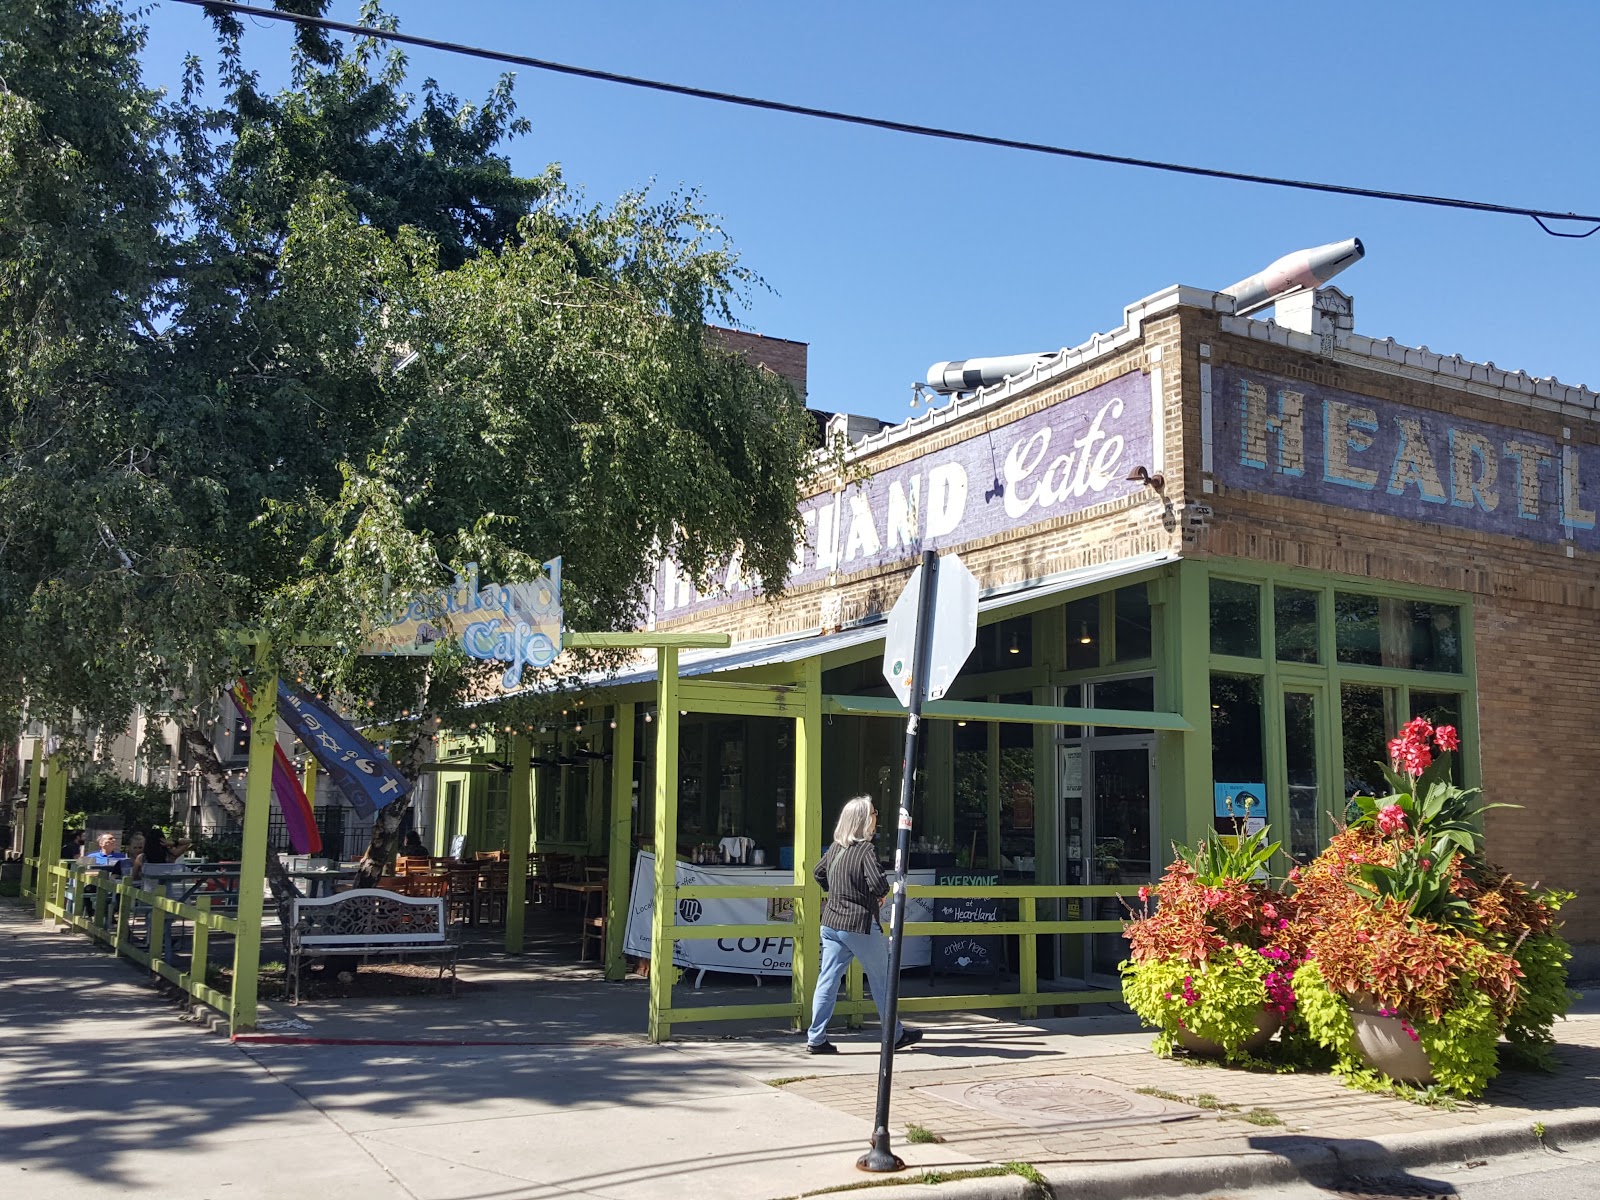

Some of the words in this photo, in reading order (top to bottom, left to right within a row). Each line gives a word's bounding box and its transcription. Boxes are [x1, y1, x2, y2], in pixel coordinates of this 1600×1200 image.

[1240, 377, 1597, 531] HEARTL
[664, 461, 968, 612] HATLAND
[1003, 397, 1125, 519] Cafe
[463, 617, 555, 689] Cafe
[675, 876, 696, 886] Cffee
[954, 907, 998, 921] Heartland
[944, 940, 967, 956] enter
[968, 938, 987, 957] here
[762, 957, 792, 970] Open
